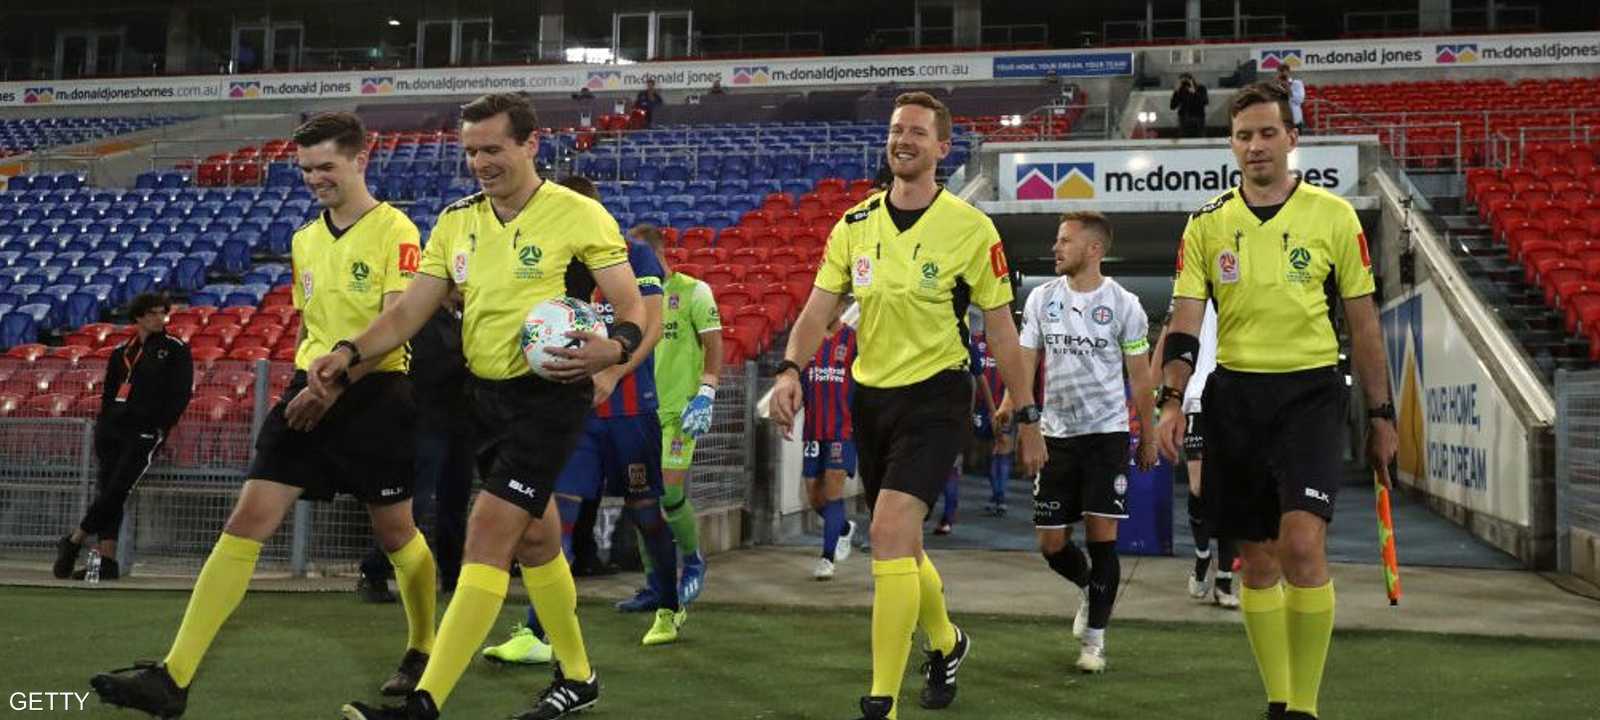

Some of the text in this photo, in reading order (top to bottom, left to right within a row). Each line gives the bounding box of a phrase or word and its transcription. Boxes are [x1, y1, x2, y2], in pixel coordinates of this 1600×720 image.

[1305, 47, 1423, 65] mcdonald jones
[1481, 42, 1600, 60] mcdonaldjones
[771, 63, 970, 81] mcdonaldjoneshomes.com.au
[319, 80, 351, 95] jones
[1045, 332, 1109, 350] ETIHAD
[508, 479, 536, 499] BLK
[1304, 487, 1330, 504] BLK
